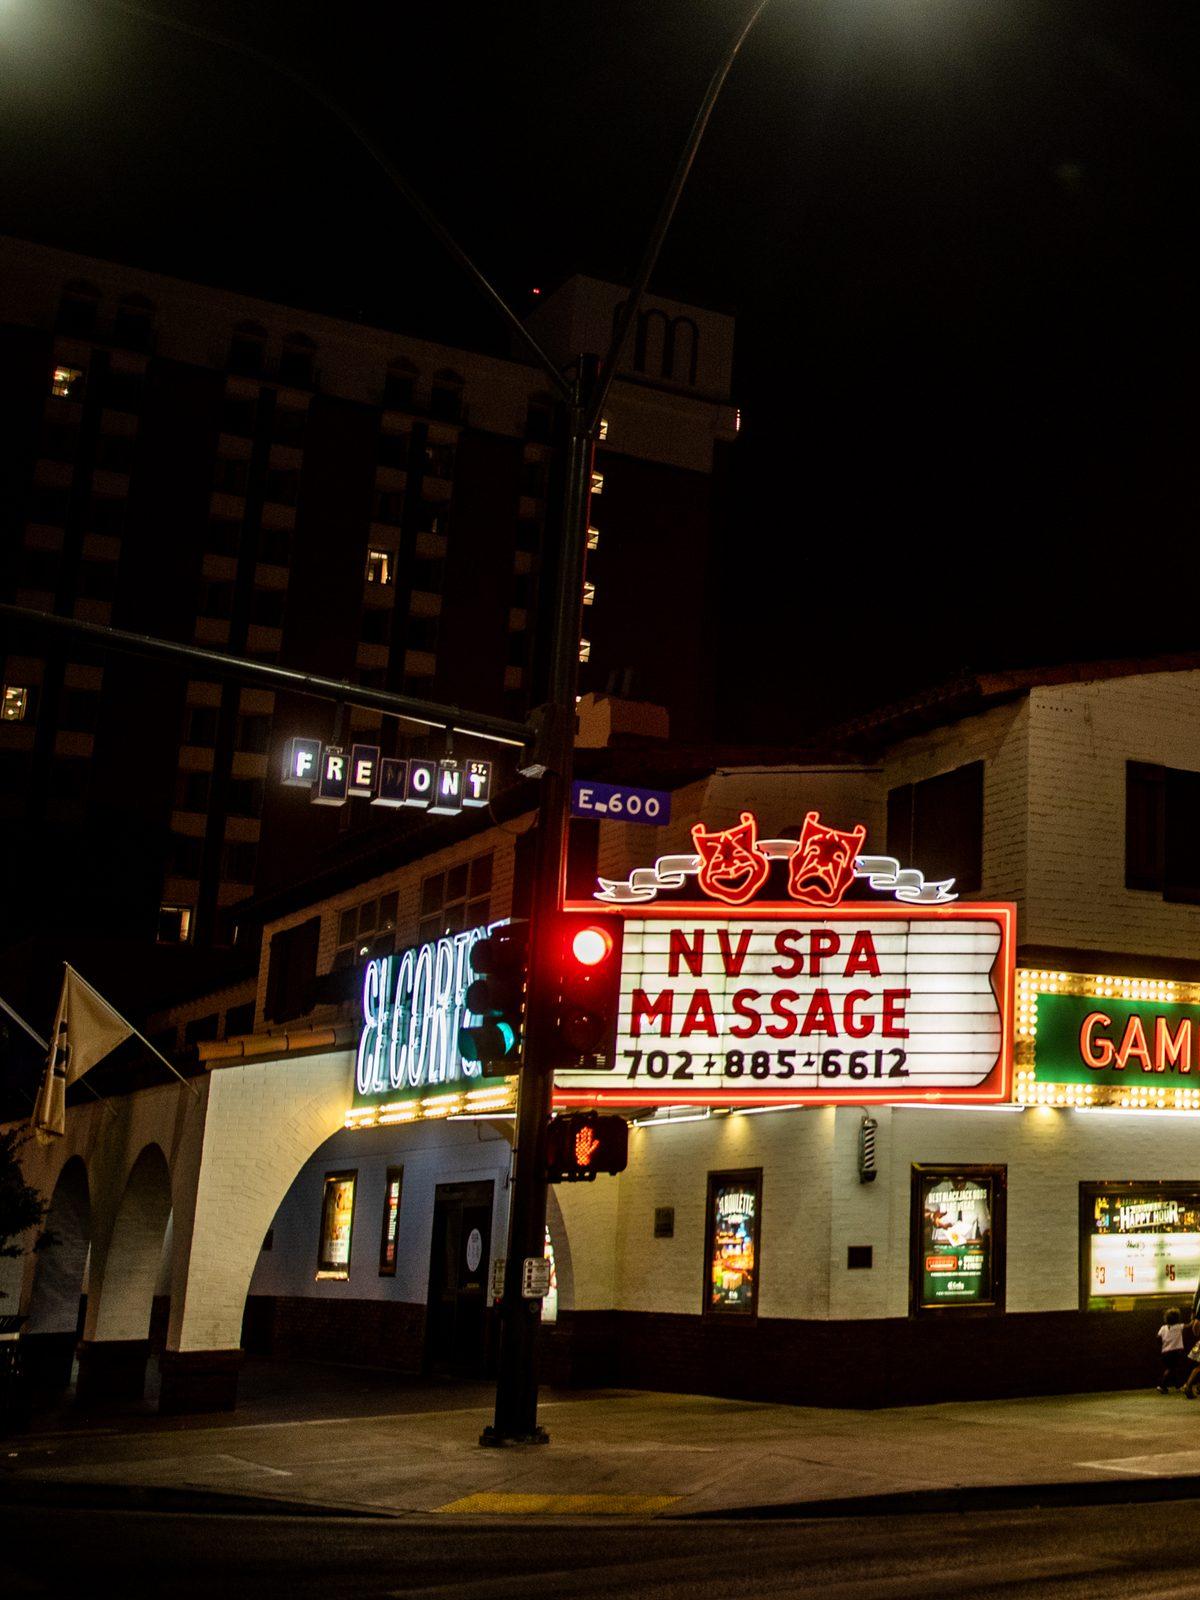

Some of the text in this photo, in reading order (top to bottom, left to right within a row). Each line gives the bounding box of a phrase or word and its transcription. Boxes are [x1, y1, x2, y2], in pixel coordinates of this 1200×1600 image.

[667, 928, 882, 979] NV SPA
[390, 918, 513, 1090] CORT
[628, 988, 912, 1040] MASSAGE
